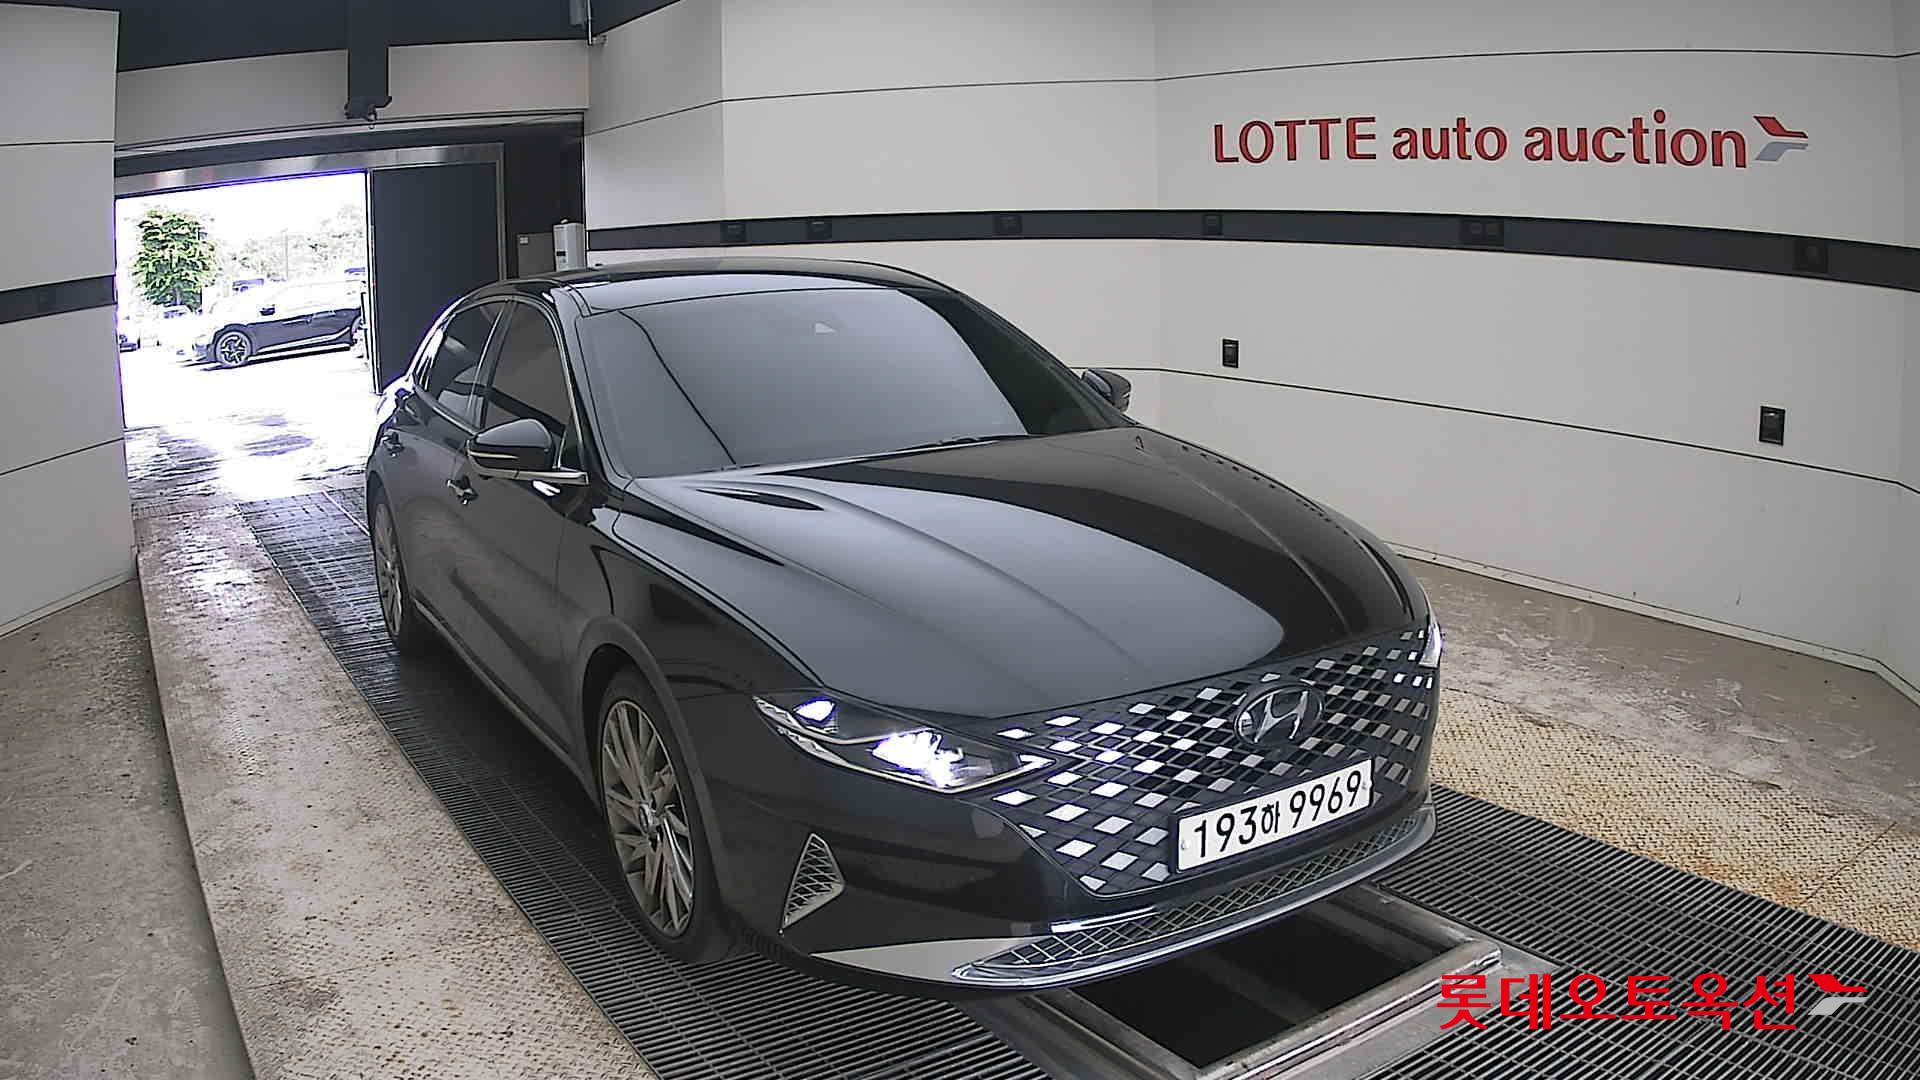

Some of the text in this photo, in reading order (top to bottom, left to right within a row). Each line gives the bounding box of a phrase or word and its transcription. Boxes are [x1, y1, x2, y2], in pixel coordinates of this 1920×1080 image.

[1214, 109, 1747, 168] LOTTE auto auction
[1194, 770, 1362, 858] 193하 9969
